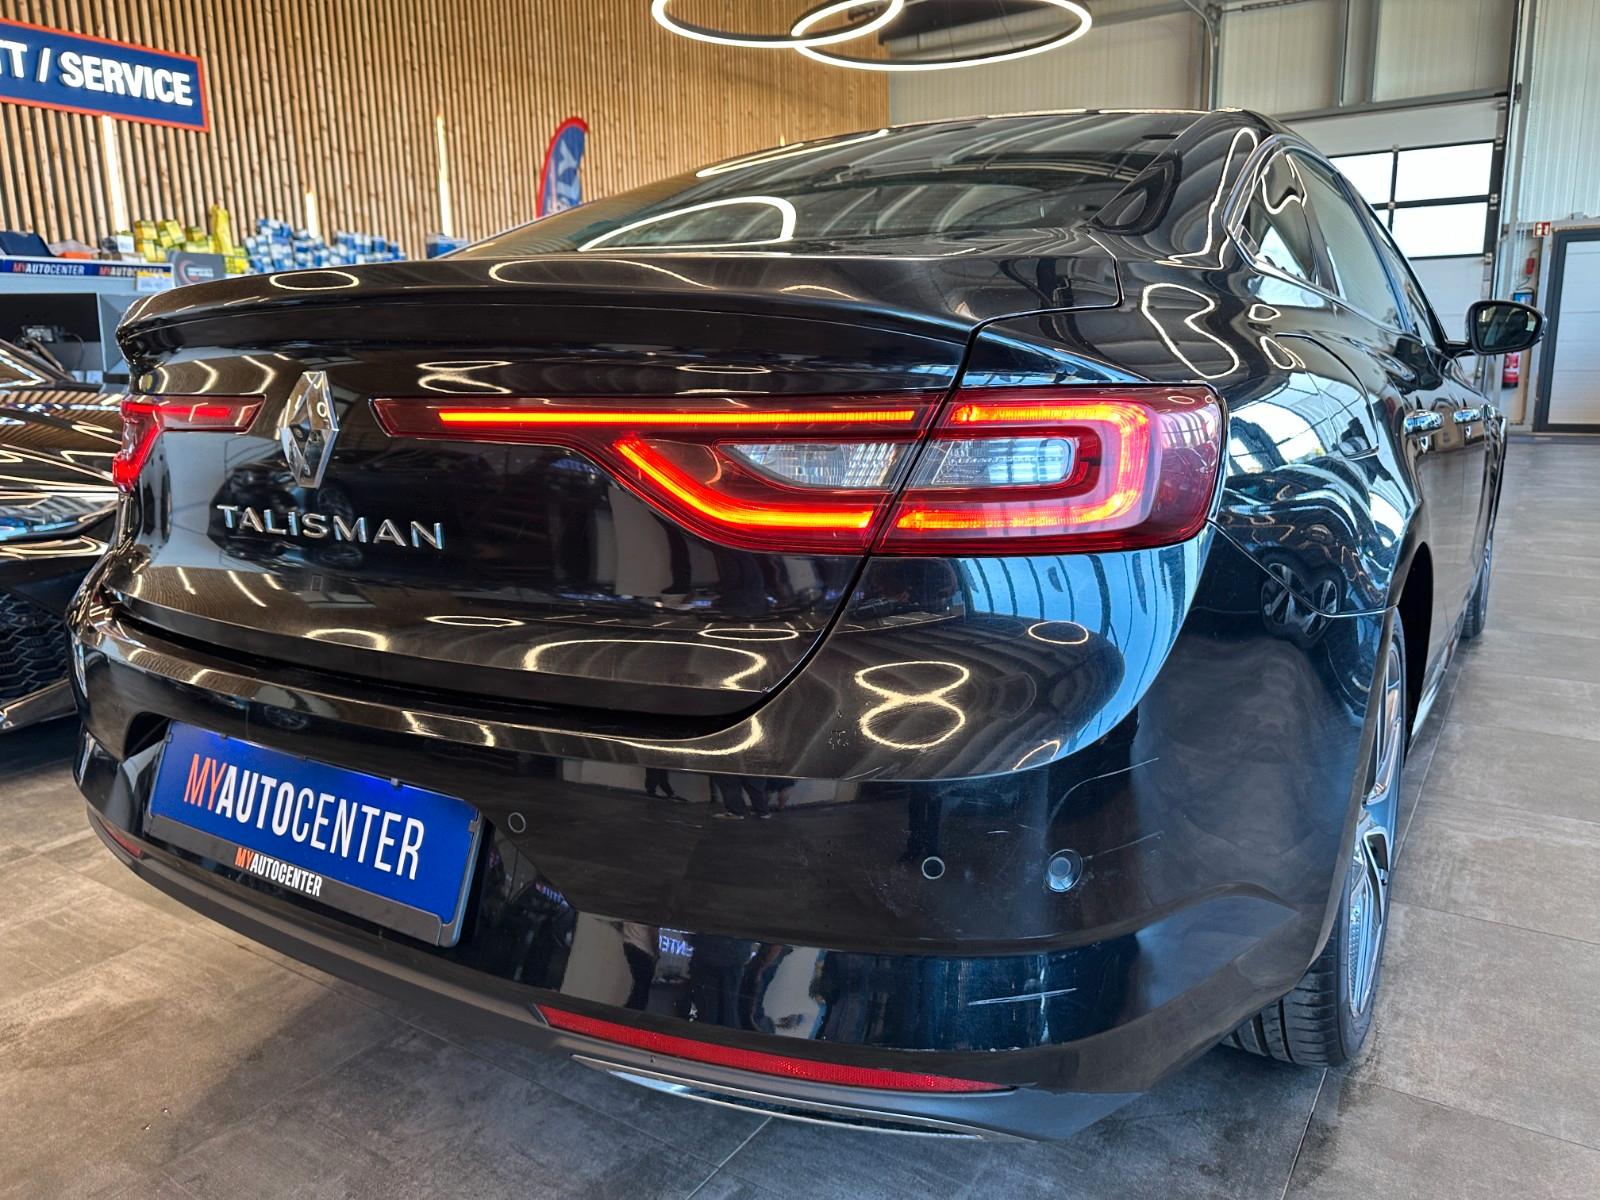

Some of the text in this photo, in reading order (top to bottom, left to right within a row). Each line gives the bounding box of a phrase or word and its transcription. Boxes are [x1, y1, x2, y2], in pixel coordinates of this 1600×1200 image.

[37, 47, 51, 83] /
[59, 51, 193, 106] SERVICE
[13, 262, 85, 275] MYAUTOCENTER
[217, 504, 443, 550] TALISMAN
[184, 753, 425, 880] MYAUTOCENTER
[235, 847, 323, 897] MYAUTOCENTER
